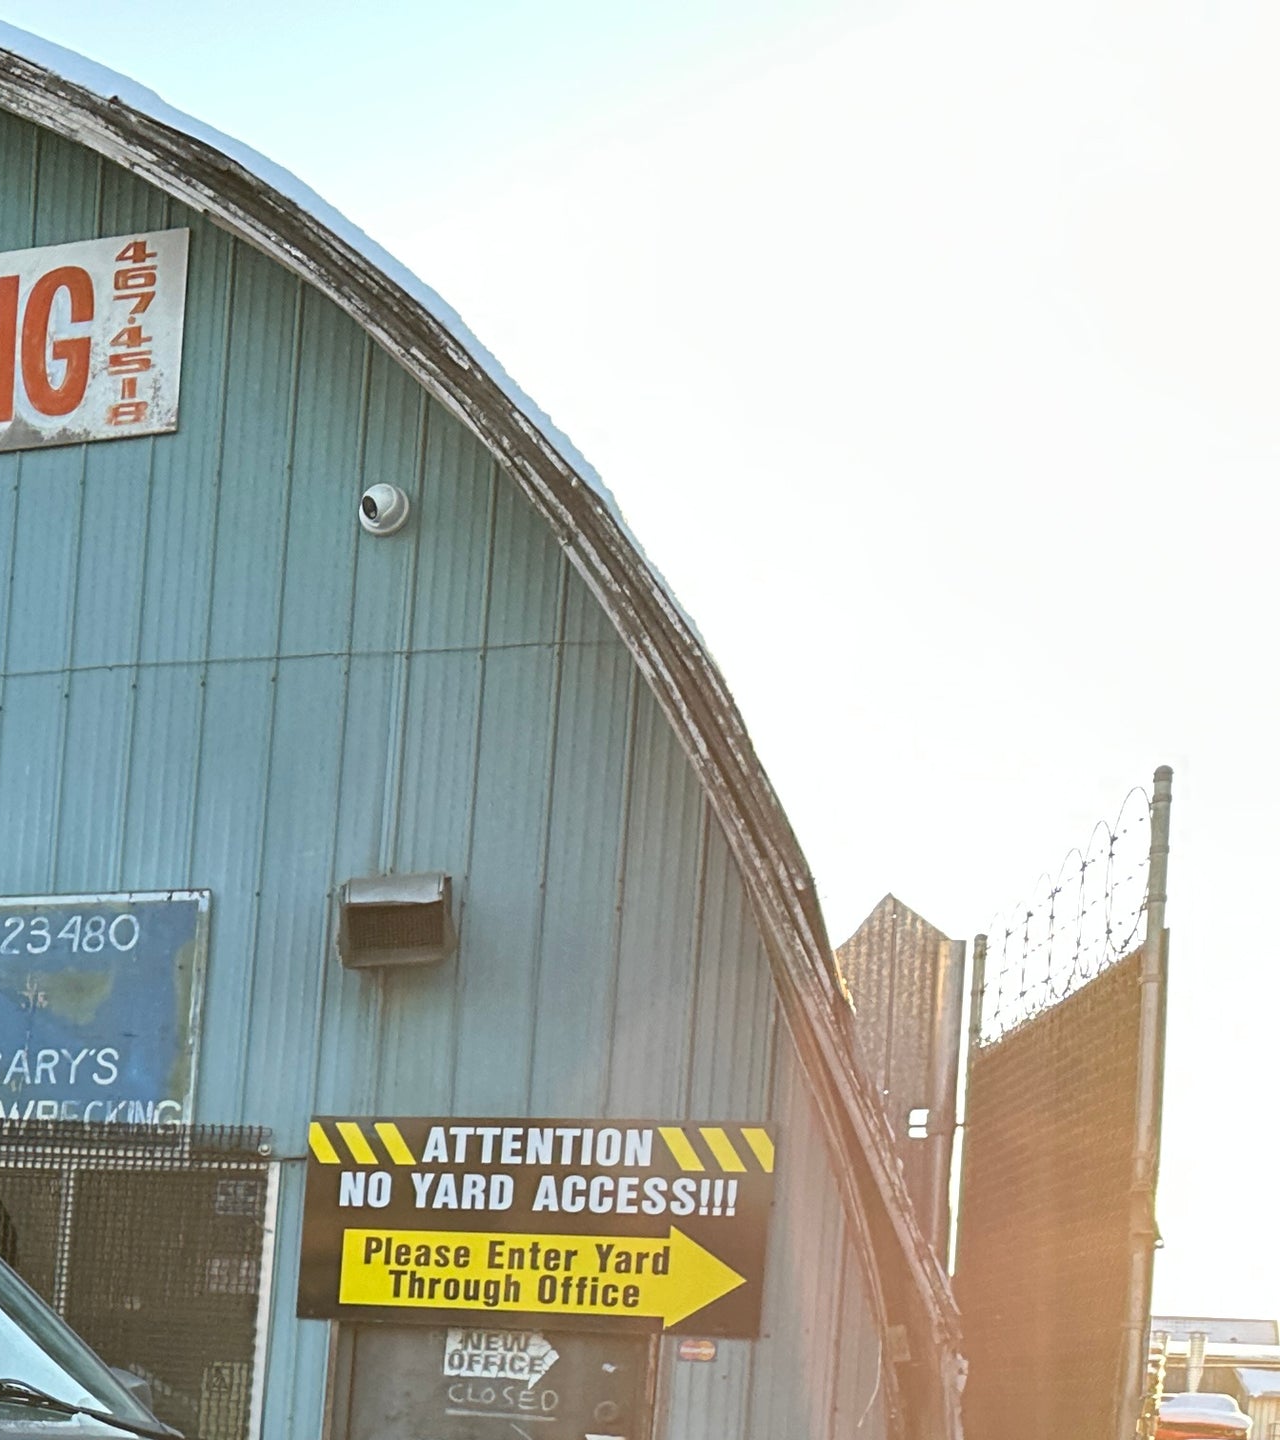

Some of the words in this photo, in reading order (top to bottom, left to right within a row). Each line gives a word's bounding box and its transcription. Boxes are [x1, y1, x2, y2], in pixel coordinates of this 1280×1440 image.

[422, 1126, 653, 1167] ATTENTION
[339, 1171, 392, 1208] NO
[411, 1173, 514, 1211] YARD
[532, 1176, 739, 1217] ACCESS!!!
[363, 1236, 471, 1268] Please
[487, 1240, 578, 1272] Enter
[594, 1244, 670, 1276] Yard
[388, 1270, 520, 1307] Through
[540, 1274, 640, 1308] Office
[463, 1331, 527, 1350] NEW
[447, 1348, 544, 1374] OFFICE
[447, 1383, 560, 1411] CLOSED
